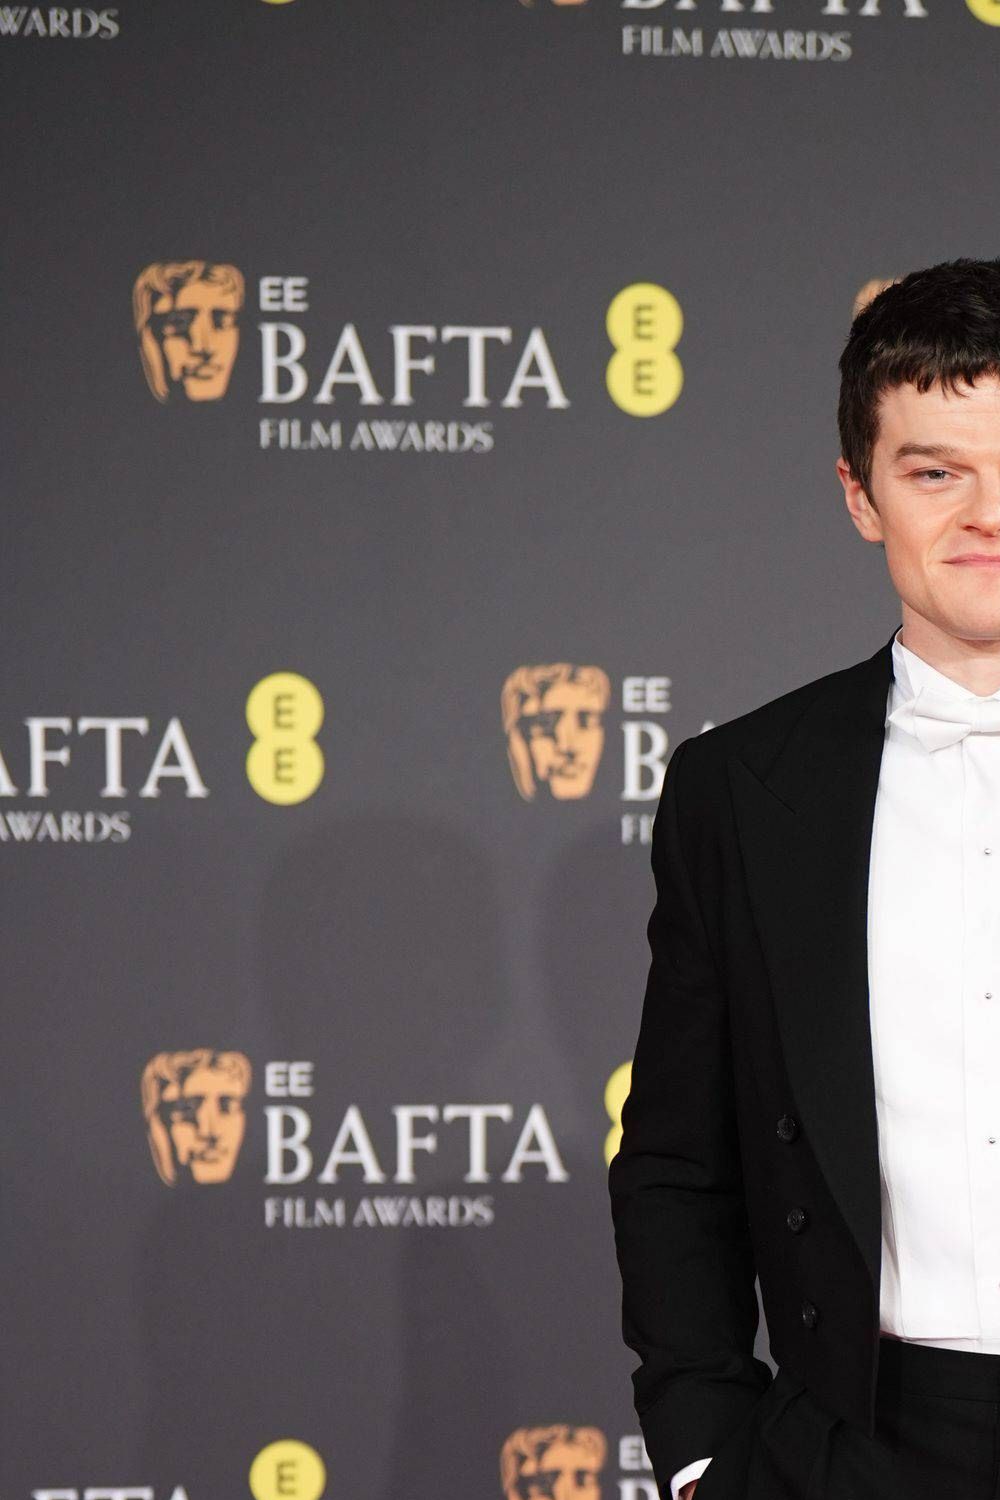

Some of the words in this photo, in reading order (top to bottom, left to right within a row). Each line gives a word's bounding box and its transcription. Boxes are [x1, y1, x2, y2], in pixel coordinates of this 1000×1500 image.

[0, 6, 120, 39] WARDS
[621, 24, 704, 57] FILM
[710, 28, 852, 61] AWARDS
[259, 276, 309, 313] EE
[259, 323, 570, 409] BAFTA
[259, 418, 342, 450] FILM
[350, 420, 494, 453] AWARDS
[622, 676, 672, 713] EE
[0, 716, 209, 799] FTA
[264, 1061, 313, 1097] EE
[264, 1103, 569, 1184] BAFTA
[264, 1197, 346, 1228] FILM
[353, 1196, 494, 1227] AWARDS
